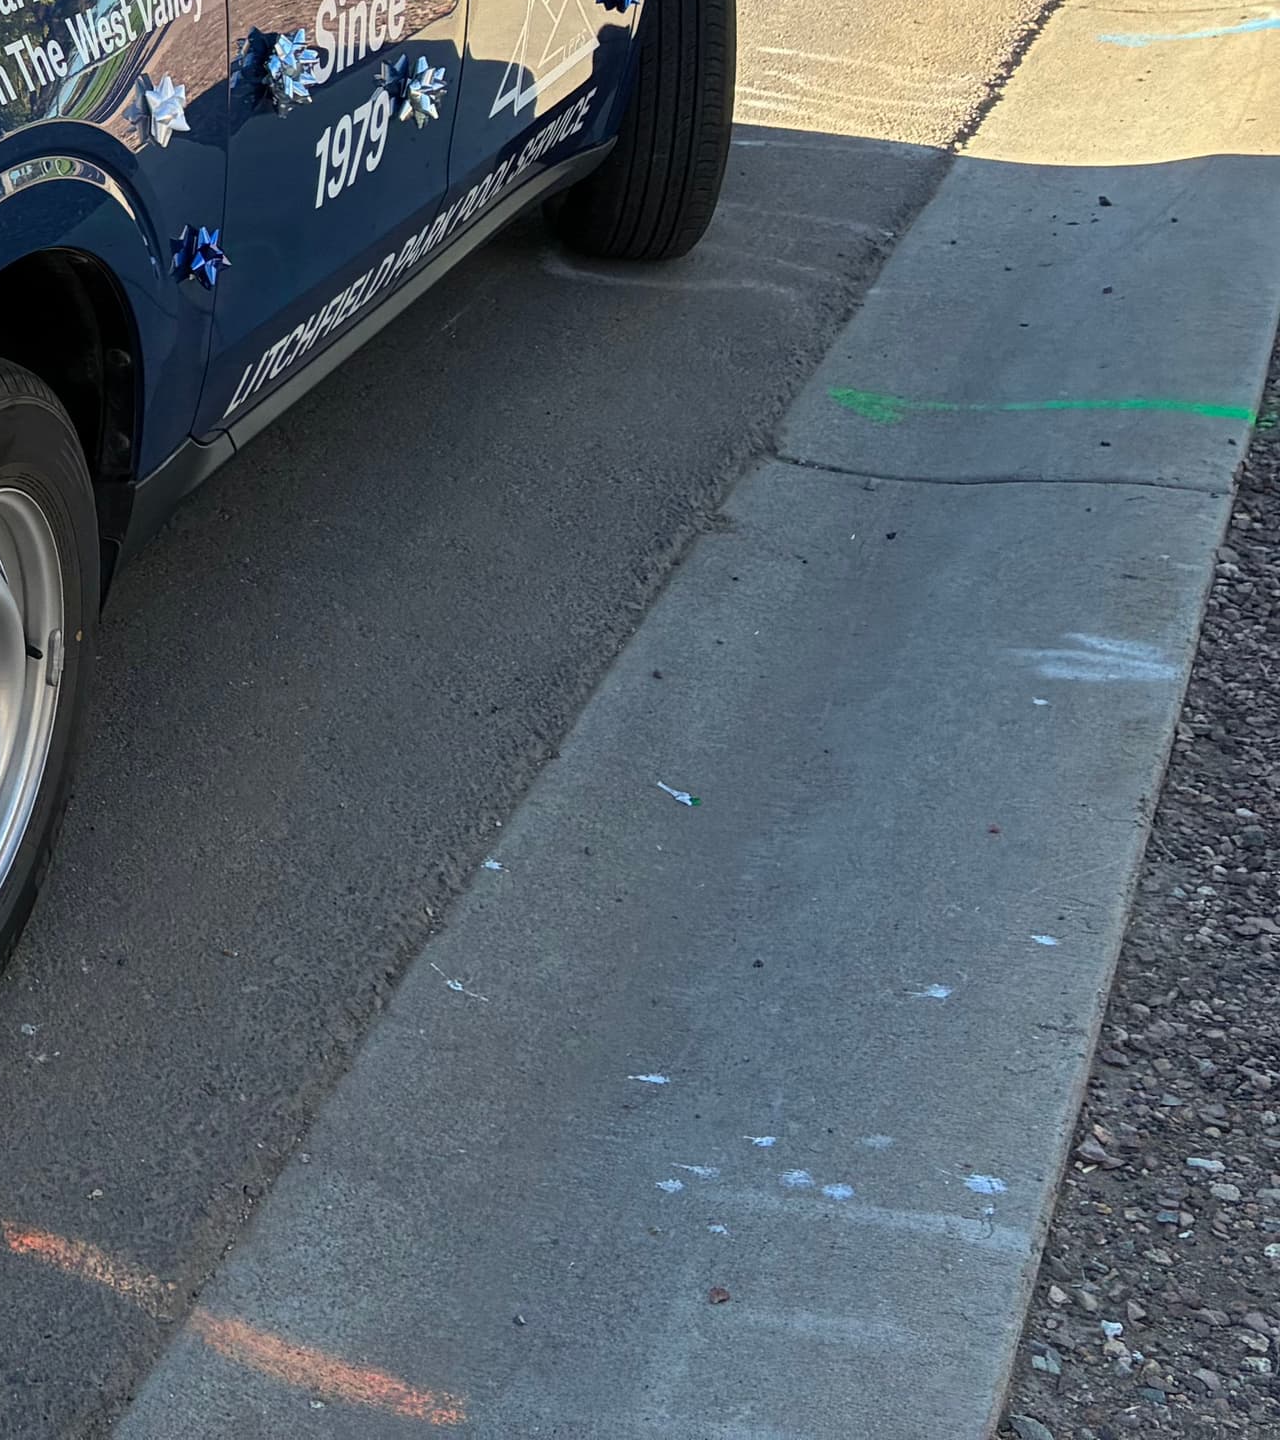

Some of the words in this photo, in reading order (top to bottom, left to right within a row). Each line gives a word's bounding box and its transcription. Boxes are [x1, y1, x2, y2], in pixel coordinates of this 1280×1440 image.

[3, 33, 69, 93] The
[315, 89, 391, 210] 1979
[222, 252, 396, 420] LITCHFIELD
[395, 196, 466, 279] PARK
[462, 153, 518, 223] POOL
[514, 86, 599, 181] SERVICE
